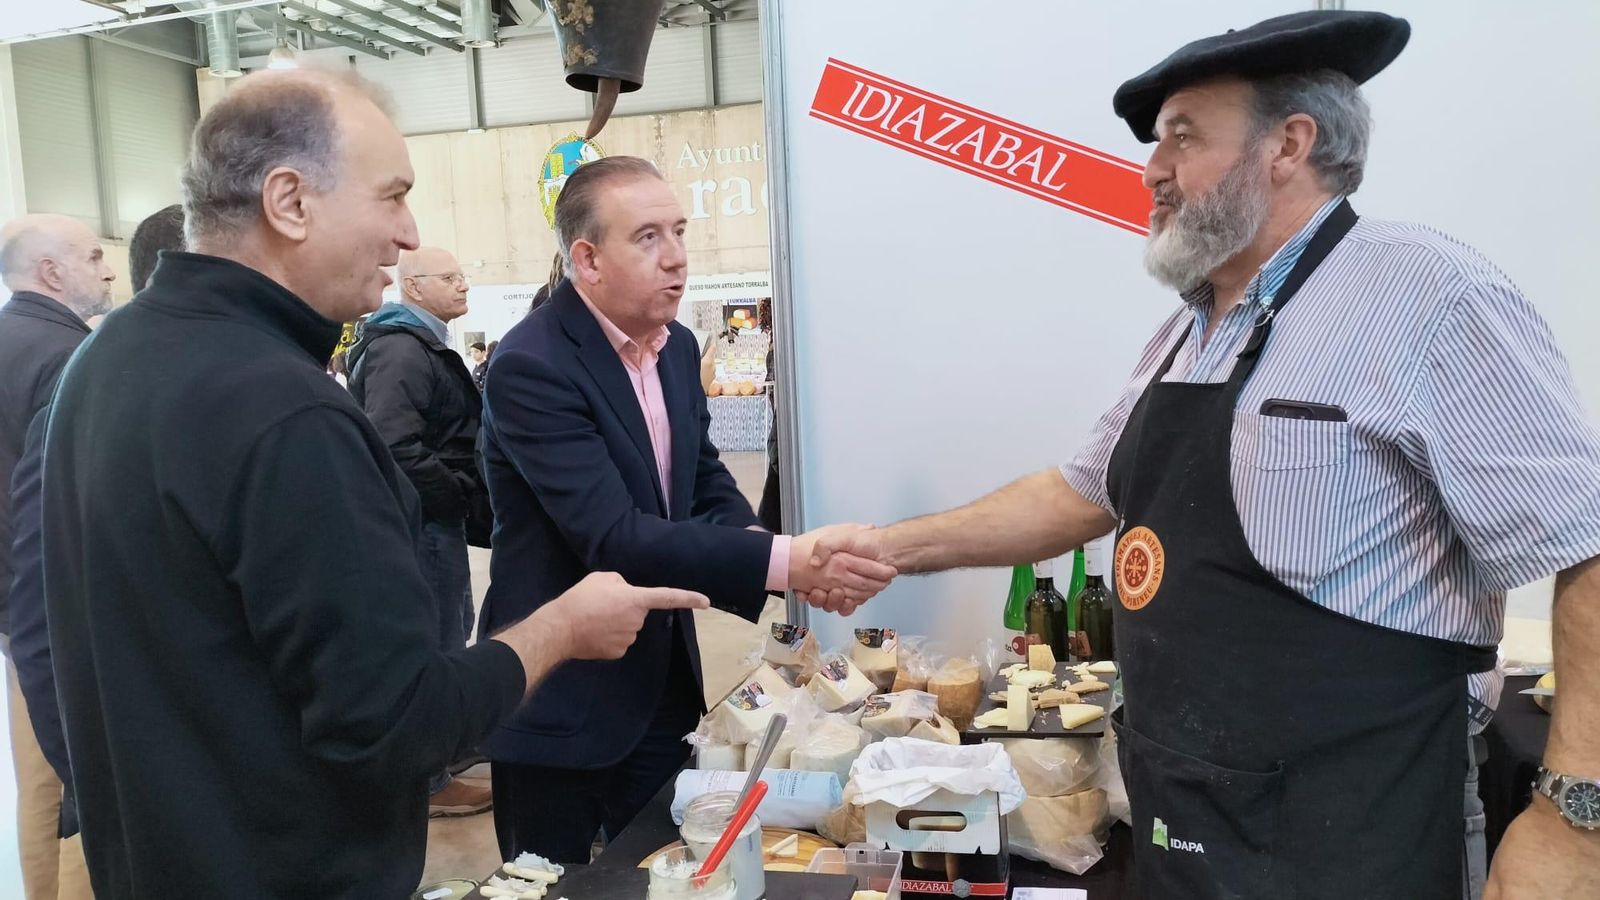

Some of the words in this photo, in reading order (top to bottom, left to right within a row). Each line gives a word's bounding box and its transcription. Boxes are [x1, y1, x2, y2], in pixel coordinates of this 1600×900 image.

[841, 81, 1067, 192] IDIAZABAL
[676, 141, 764, 172] Ayunt
[687, 176, 768, 220] ra
[503, 293, 534, 301] CORTIJO
[1170, 838, 1205, 854] IDAPA
